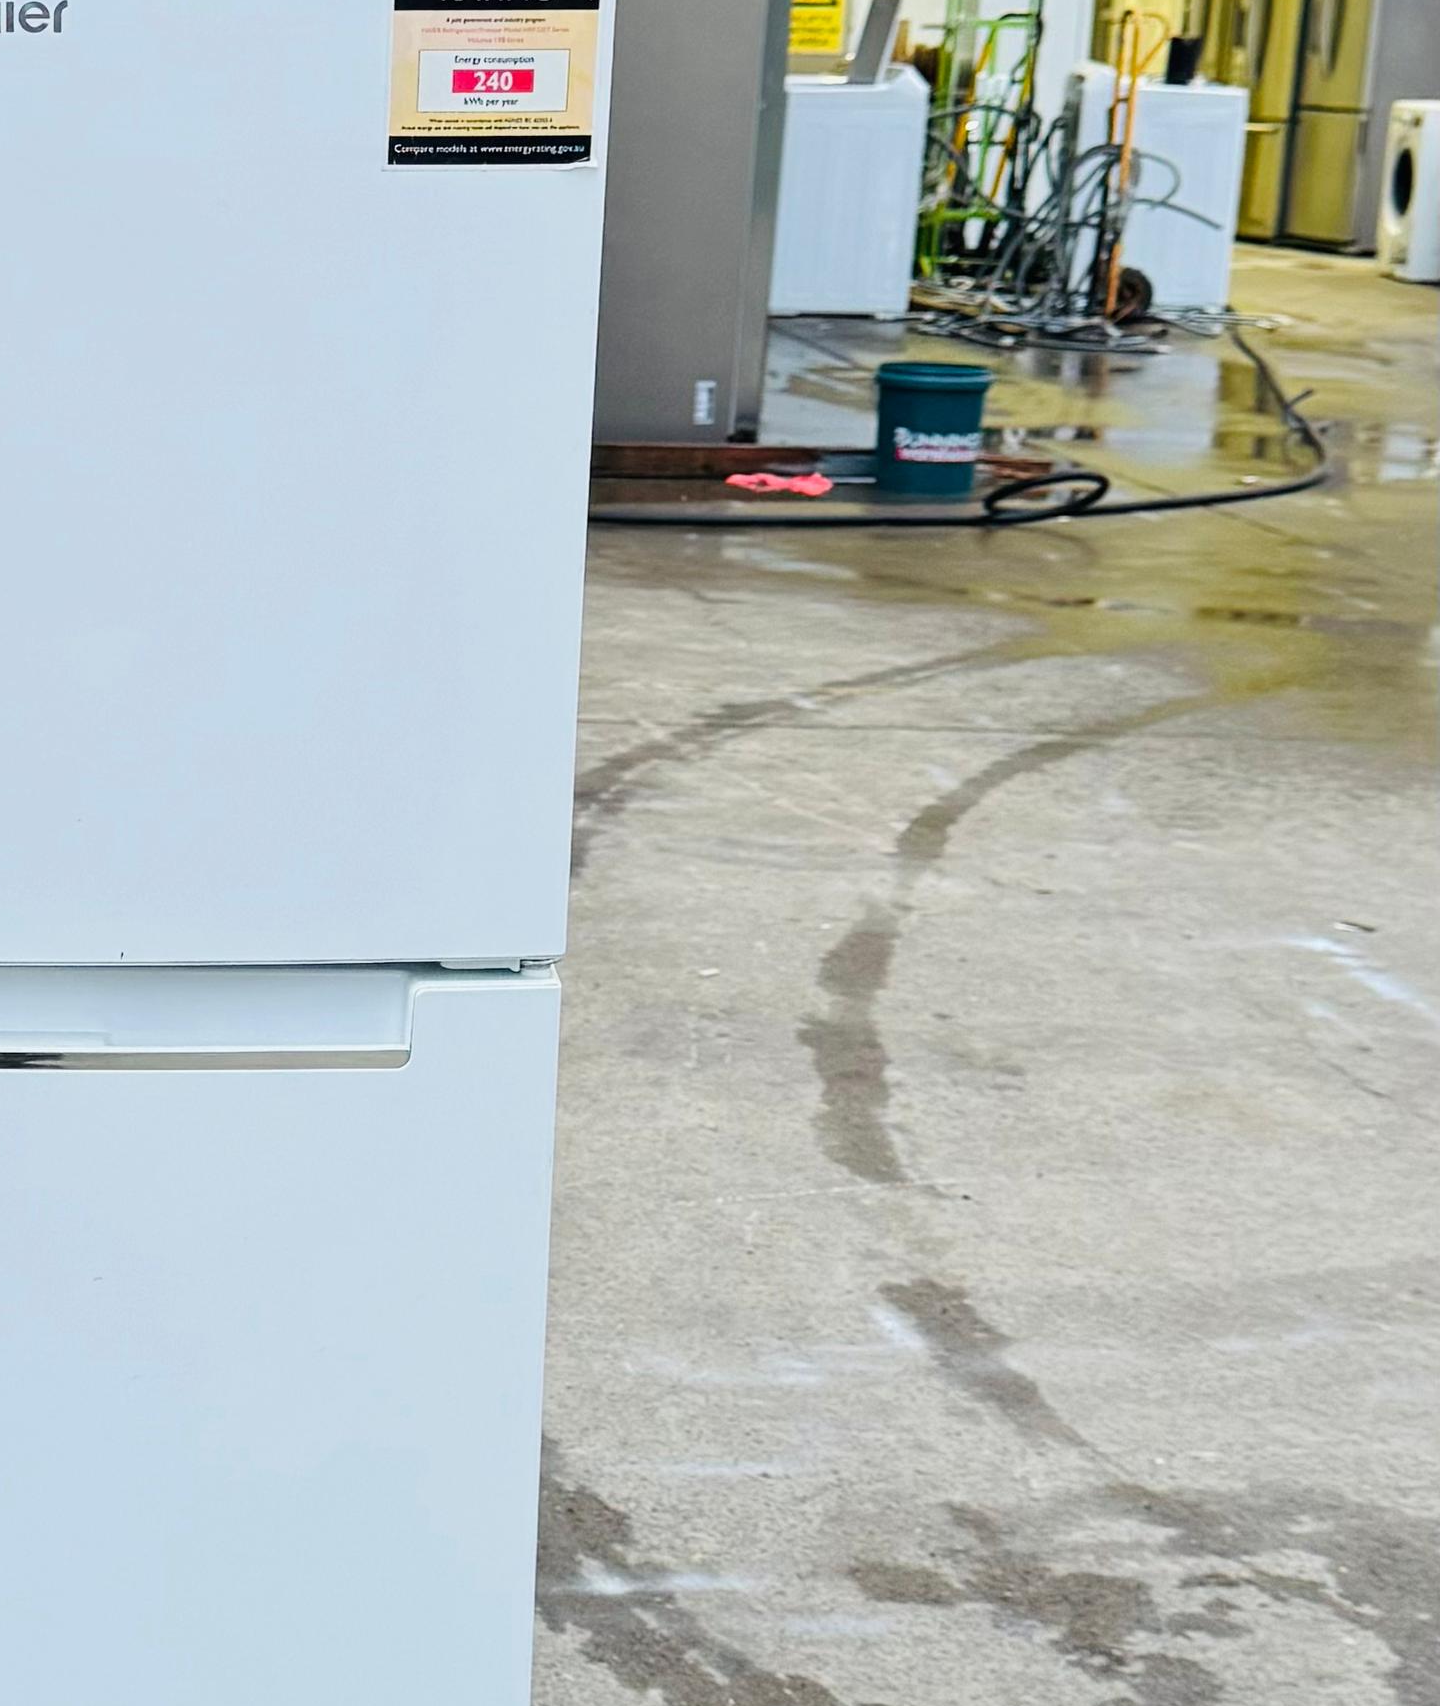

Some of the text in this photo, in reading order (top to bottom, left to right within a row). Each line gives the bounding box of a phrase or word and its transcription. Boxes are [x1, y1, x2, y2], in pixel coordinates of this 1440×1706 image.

[454, 55, 535, 65] Energy consumption
[473, 71, 513, 91] 240
[486, 98, 499, 107] per
[501, 98, 519, 107] year
[394, 144, 585, 155] Compare models at www.energyrating.gov.au
